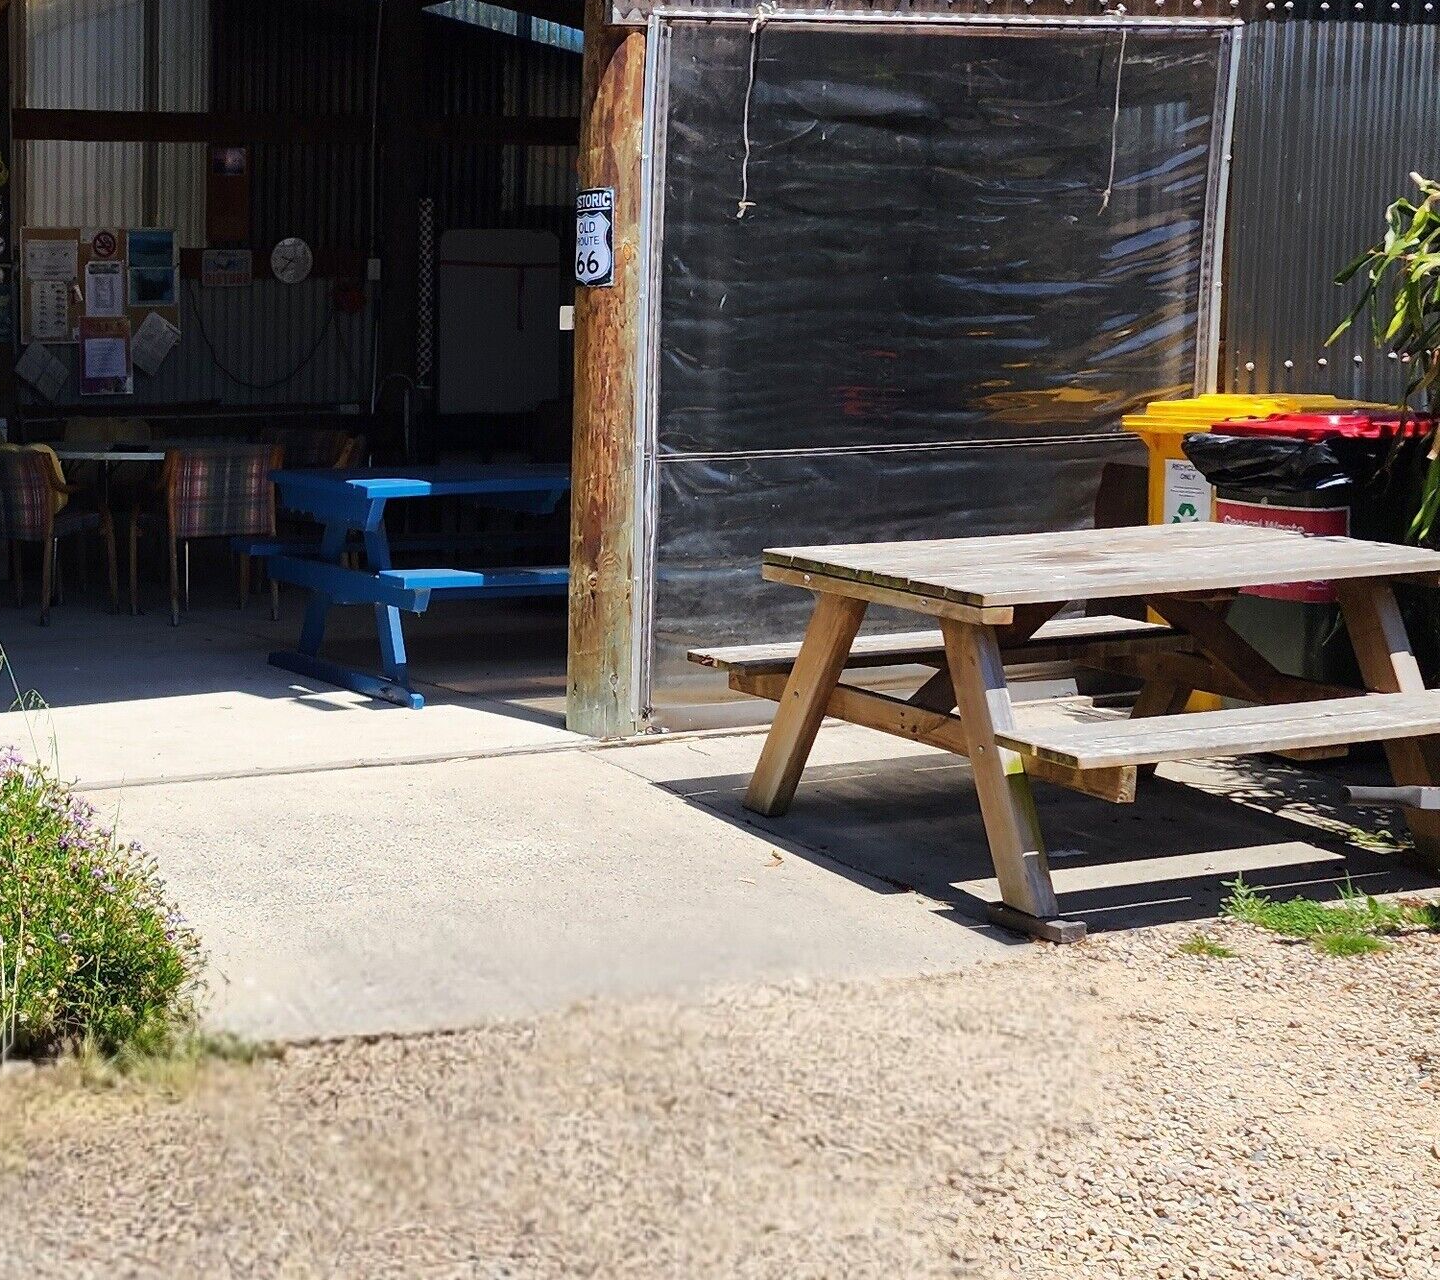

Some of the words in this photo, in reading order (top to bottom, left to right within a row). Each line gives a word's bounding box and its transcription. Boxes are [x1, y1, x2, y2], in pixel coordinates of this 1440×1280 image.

[576, 192, 611, 209] STORIC
[579, 221, 596, 234] OLD
[577, 250, 599, 276] 66
[1180, 473, 1197, 481] ONLY
